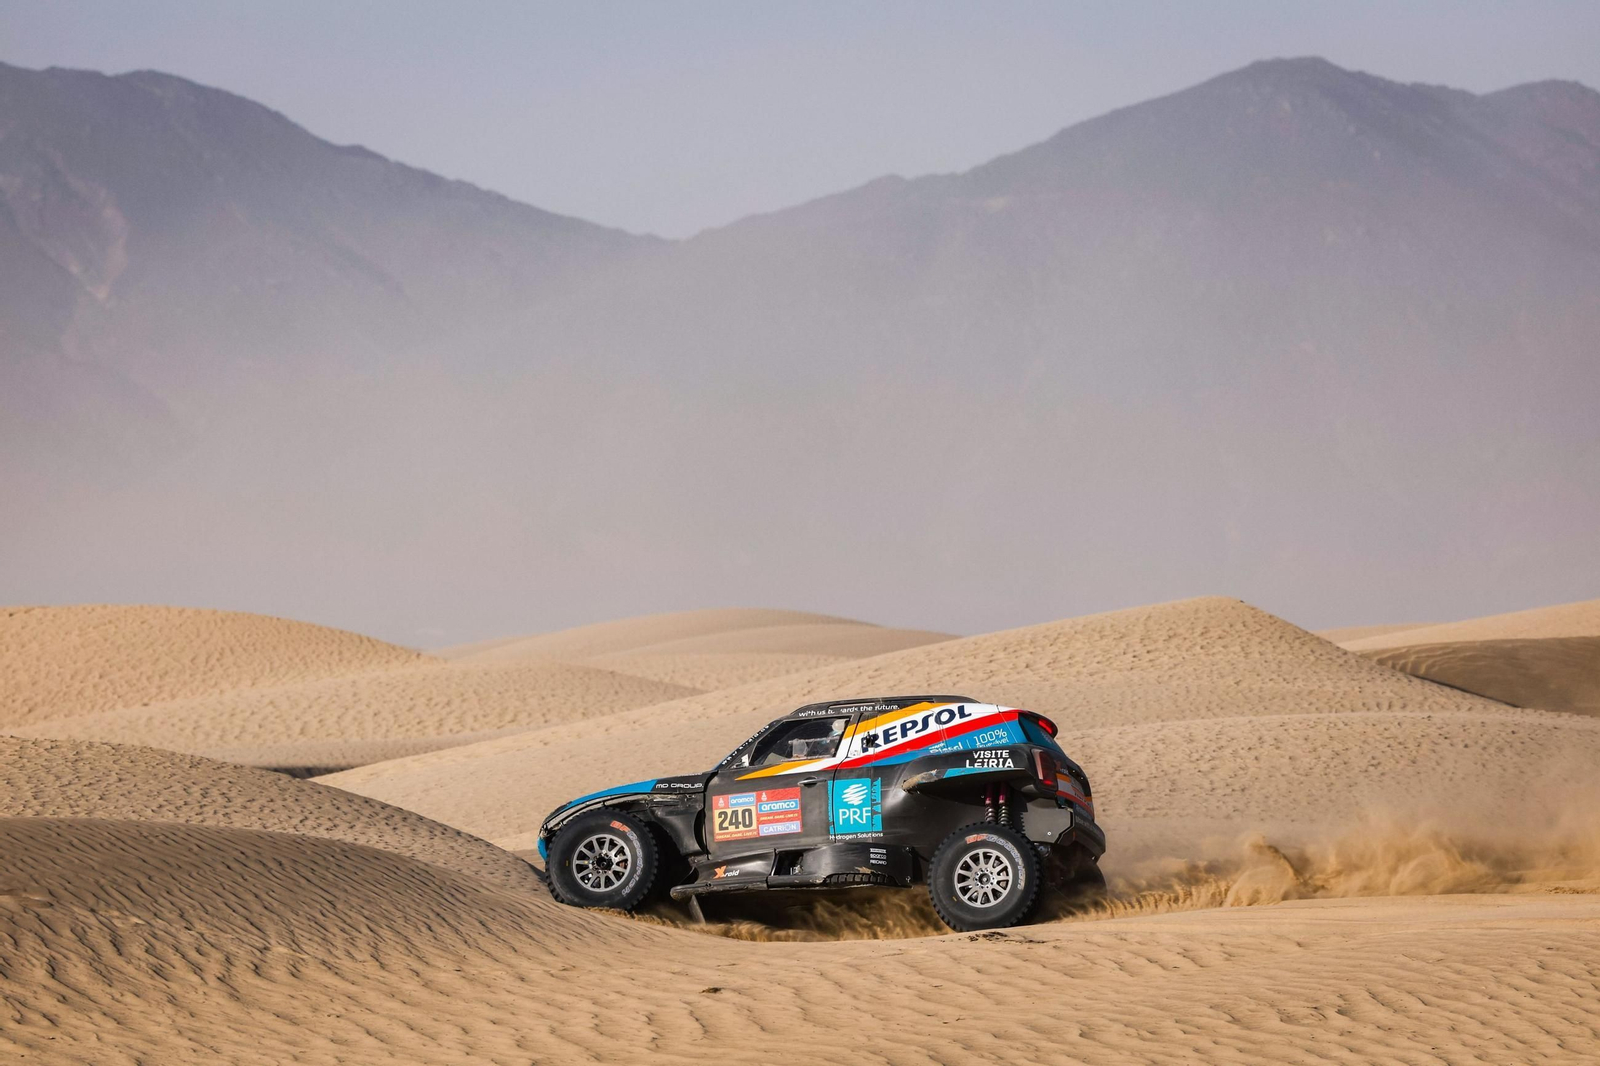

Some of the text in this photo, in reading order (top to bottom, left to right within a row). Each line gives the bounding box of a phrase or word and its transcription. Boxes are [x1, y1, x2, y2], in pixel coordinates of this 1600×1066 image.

[860, 704, 873, 712] the
[861, 705, 972, 753] REPSOL
[974, 728, 1007, 746] 100%
[973, 750, 1010, 759] VISITE
[966, 759, 1014, 769] LEIRIA
[730, 796, 754, 804] aramco
[761, 801, 796, 811] aramco
[718, 808, 753, 831] 240
[839, 807, 872, 825] PRF
